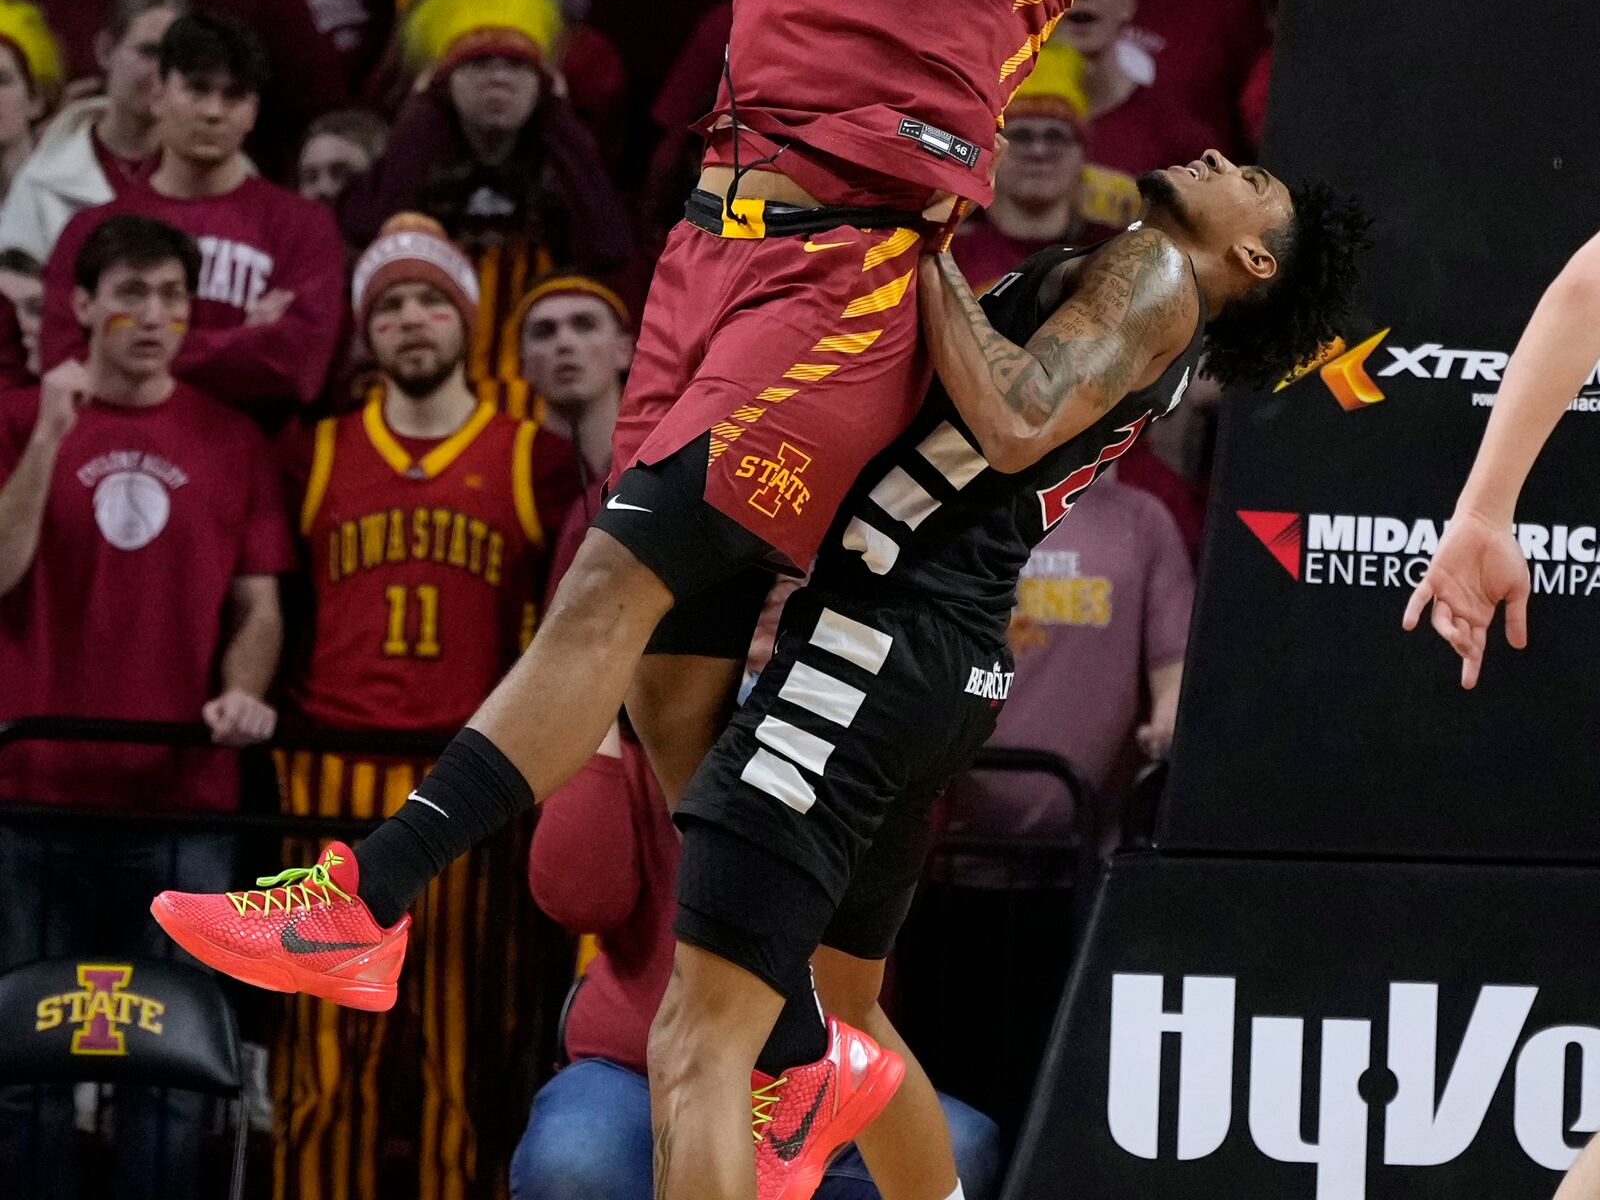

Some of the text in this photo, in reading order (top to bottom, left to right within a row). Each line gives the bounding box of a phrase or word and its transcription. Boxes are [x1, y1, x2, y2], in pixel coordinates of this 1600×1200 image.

[954, 143, 968, 156] 46
[196, 235, 273, 312] TATE
[735, 455, 811, 516] STATE
[329, 505, 504, 586] IOWA STATE
[1305, 552, 1432, 588] ENERG
[383, 583, 442, 658] 11
[964, 660, 1015, 701] BEARCAT
[35, 990, 167, 1036] STATE
